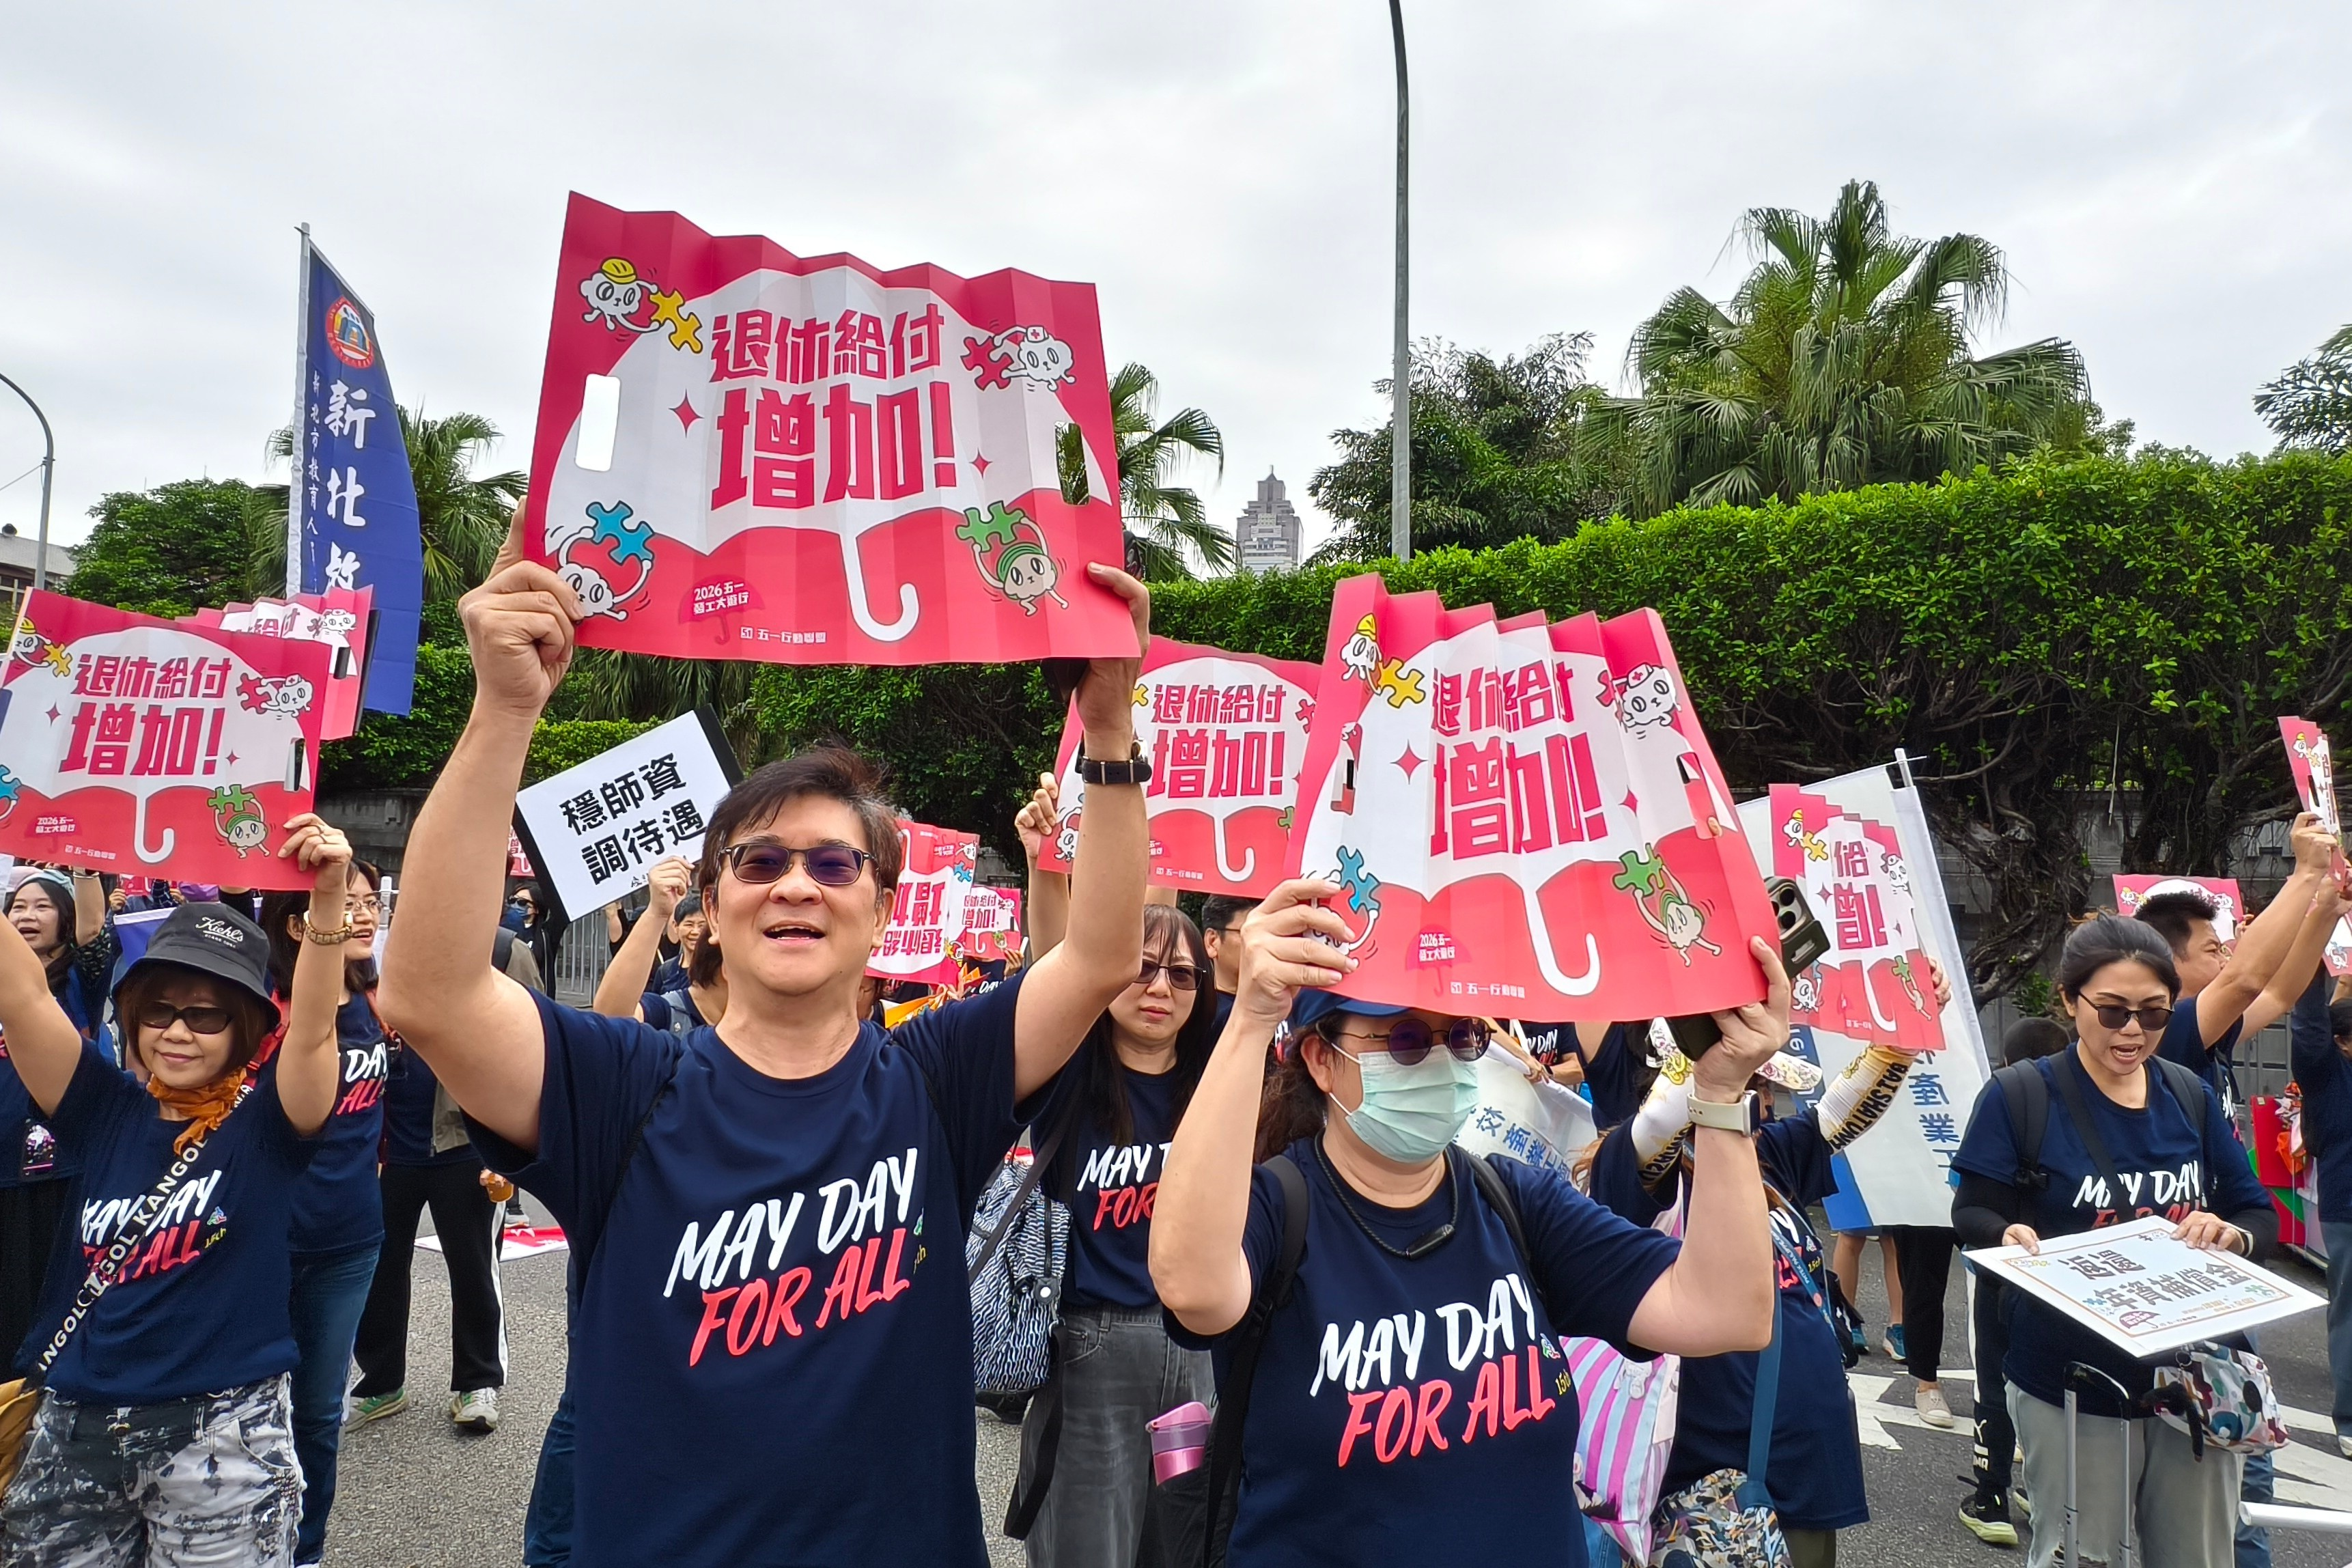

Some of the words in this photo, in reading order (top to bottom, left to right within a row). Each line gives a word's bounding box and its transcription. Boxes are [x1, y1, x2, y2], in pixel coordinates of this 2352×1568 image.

[708, 303, 944, 384] 退休給付
[710, 380, 957, 512] 增加!
[70, 654, 233, 699] 退休給付
[1152, 684, 1286, 723] 退休給付
[58, 702, 226, 776] 增加!
[1147, 728, 1285, 800] 增加!
[559, 752, 687, 837] 穩師資
[580, 798, 708, 886] 調待遇
[195, 916, 244, 942] Kiehl's
[345, 1042, 389, 1082] DAY
[1537, 1028, 1558, 1054] DAY
[1077, 1143, 1152, 1192] MAY
[2148, 1160, 2200, 1205] DAY
[145, 1169, 222, 1237] AY
[664, 1192, 805, 1298] MAY
[818, 1147, 919, 1254] DAY
[1094, 1182, 1159, 1231] FOR
[132, 1220, 201, 1279] ALL
[2058, 1250, 2146, 1280] 返還
[690, 1266, 813, 1367] FOR
[815, 1228, 910, 1329] ALL
[2093, 1262, 2252, 1310] 年資補償金
[1310, 1309, 1426, 1397] MAY
[1435, 1273, 1535, 1371] DAY
[1337, 1379, 1453, 1468] FOR
[1461, 1345, 1556, 1444] ALL
